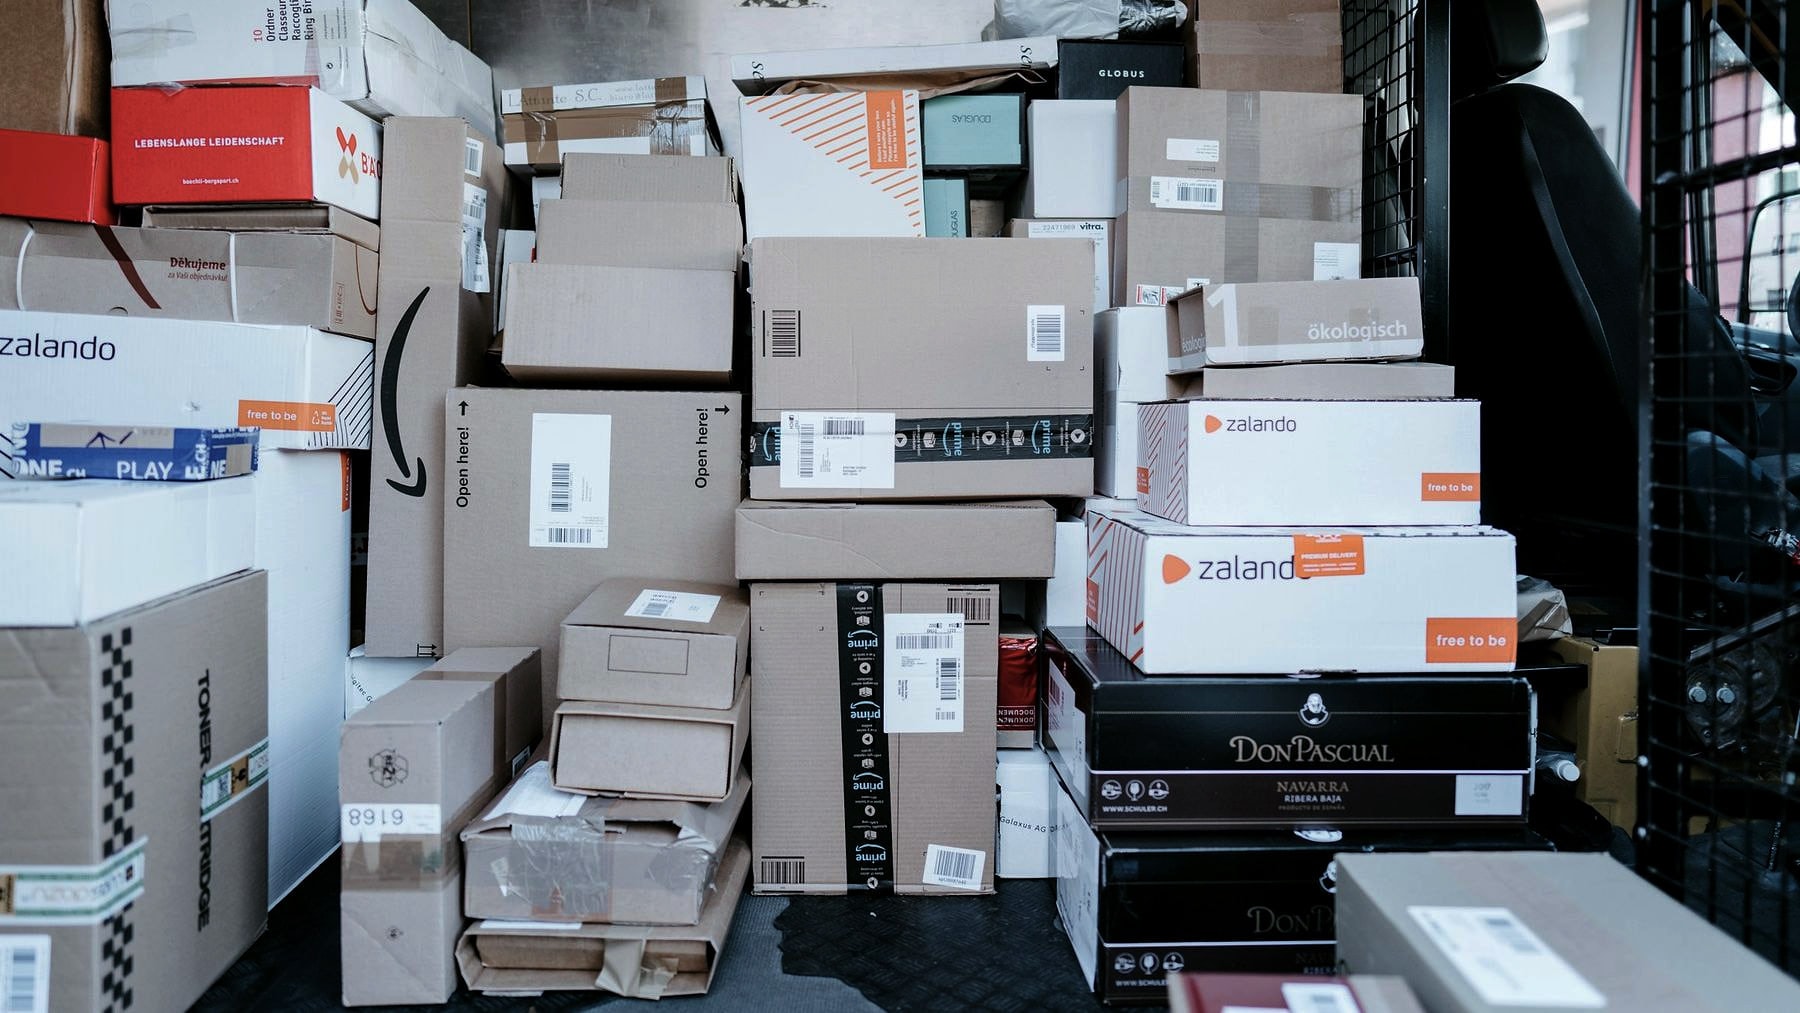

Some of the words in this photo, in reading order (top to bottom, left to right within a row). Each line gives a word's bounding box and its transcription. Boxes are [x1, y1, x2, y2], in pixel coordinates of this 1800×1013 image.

[265, 8, 275, 42] Ordner
[304, 17, 316, 40] Ring
[253, 29, 263, 42] 10
[1098, 69, 1145, 78] GLOBUS
[951, 114, 992, 124] DOUGLAS
[134, 137, 206, 148] LEBENSLANGE
[209, 136, 285, 147] LEIDENSCHAFT
[1079, 222, 1104, 231] vitra.
[169, 256, 226, 272] Děkujeme
[1307, 320, 1408, 341] ökologisch
[0, 333, 116, 361] zalando
[247, 409, 268, 420] free
[271, 411, 281, 420] to
[284, 411, 297, 421] be
[695, 408, 709, 445] here!
[1226, 415, 1297, 432] zalando
[950, 421, 965, 457] prime
[1040, 419, 1053, 454] prime
[456, 426, 470, 464] here!
[116, 460, 174, 480] PLAY
[694, 449, 710, 489] Open
[456, 468, 471, 508] Open
[1428, 483, 1447, 492] free
[1449, 484, 1459, 492] to
[1461, 483, 1473, 492] be
[1199, 555, 1311, 580] zaland
[847, 635, 878, 650] prime
[1436, 634, 1465, 646] free
[1469, 635, 1484, 646] to
[1488, 634, 1506, 646] be
[197, 668, 212, 770] TONER
[850, 709, 881, 721] prime
[853, 780, 884, 792] prime
[1276, 781, 1350, 793] NAVARRA
[1284, 794, 1319, 803] RIBERA
[1320, 794, 1342, 804] BAJA
[348, 808, 404, 826] 6168
[1102, 805, 1168, 813] WWW.SCHULER.CH
[1000, 816, 1032, 830] Galaxus
[1034, 824, 1047, 833] AG
[855, 850, 887, 864] prime
